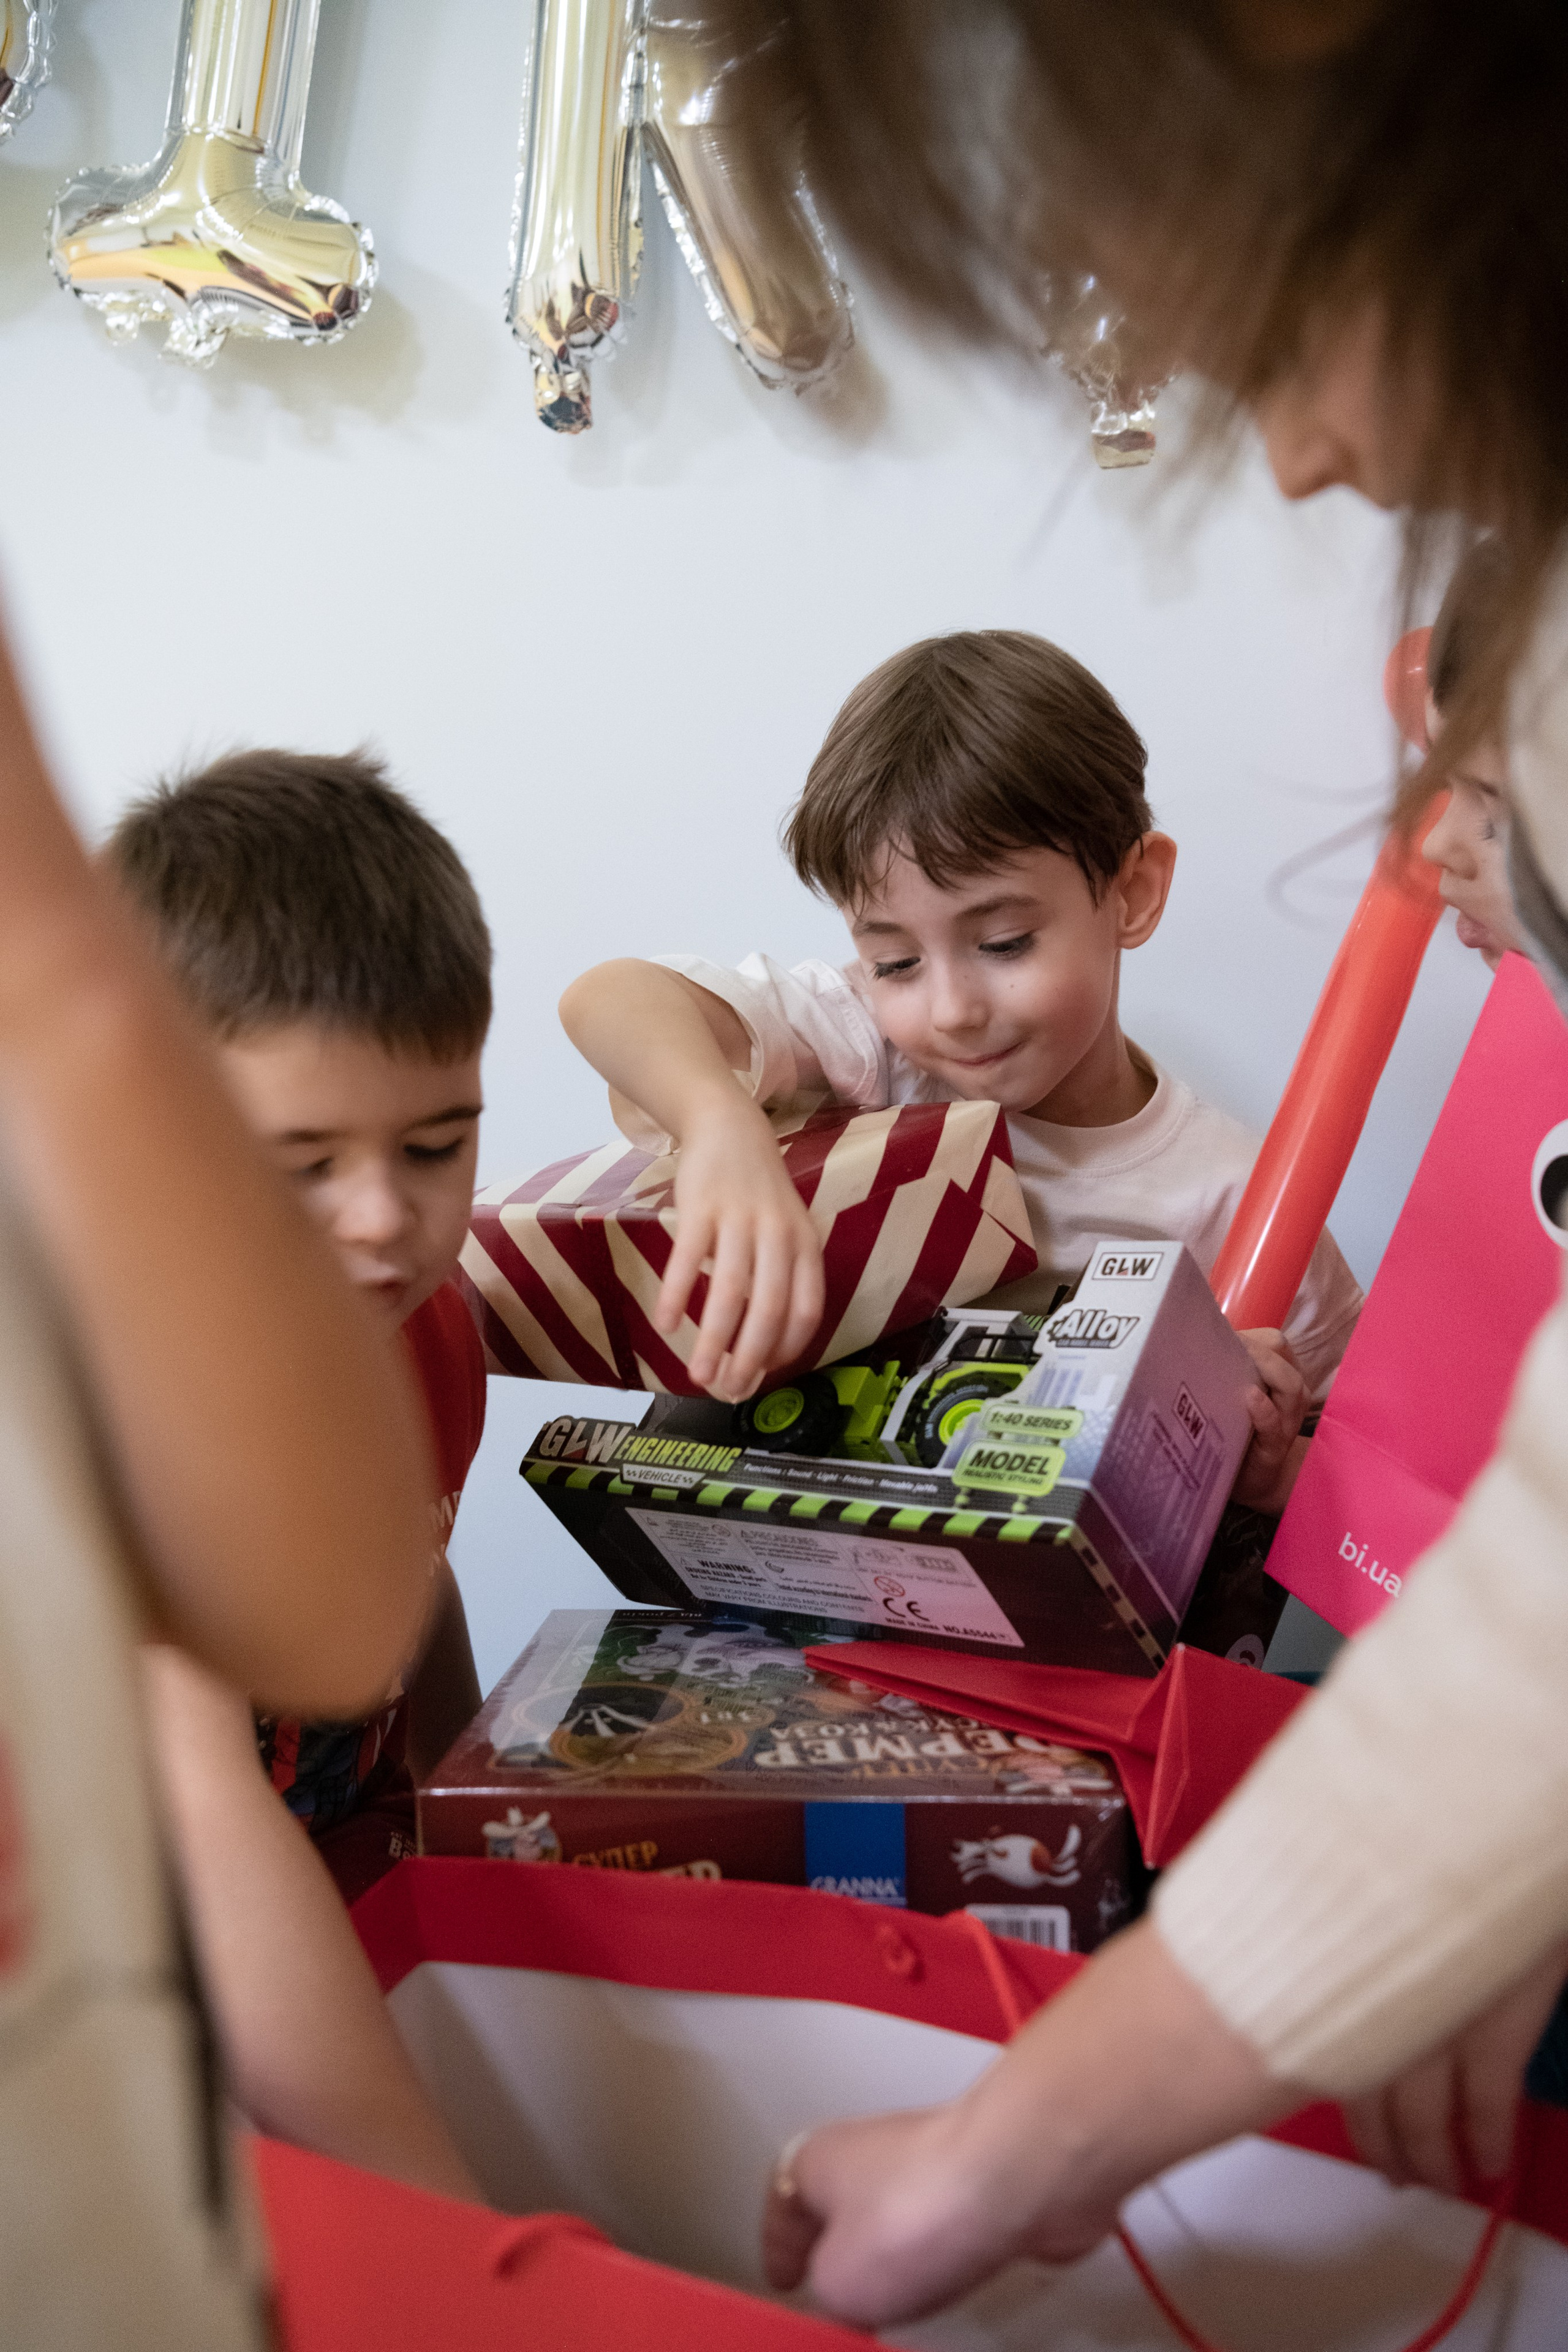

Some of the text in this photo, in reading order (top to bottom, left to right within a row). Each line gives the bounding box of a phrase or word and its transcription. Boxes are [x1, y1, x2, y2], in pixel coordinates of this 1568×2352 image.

[1101, 1257, 1154, 1276] GLW
[1053, 1309, 1140, 1348] Alloy
[990, 1411, 1072, 1430] 1:40 SERIES
[1177, 1393, 1204, 1439] GLW
[539, 1418, 742, 1472] GLW ENGINEERING
[786, 1468, 813, 1479] Sound
[816, 1471, 839, 1482] Light
[969, 1449, 1050, 1476] MODEL
[638, 1470, 682, 1483] VEHICLE
[1338, 1531, 1402, 1597] bi.ua
[883, 1597, 930, 1622] CE
[754, 1728, 1041, 1768] ЕРМЕР
